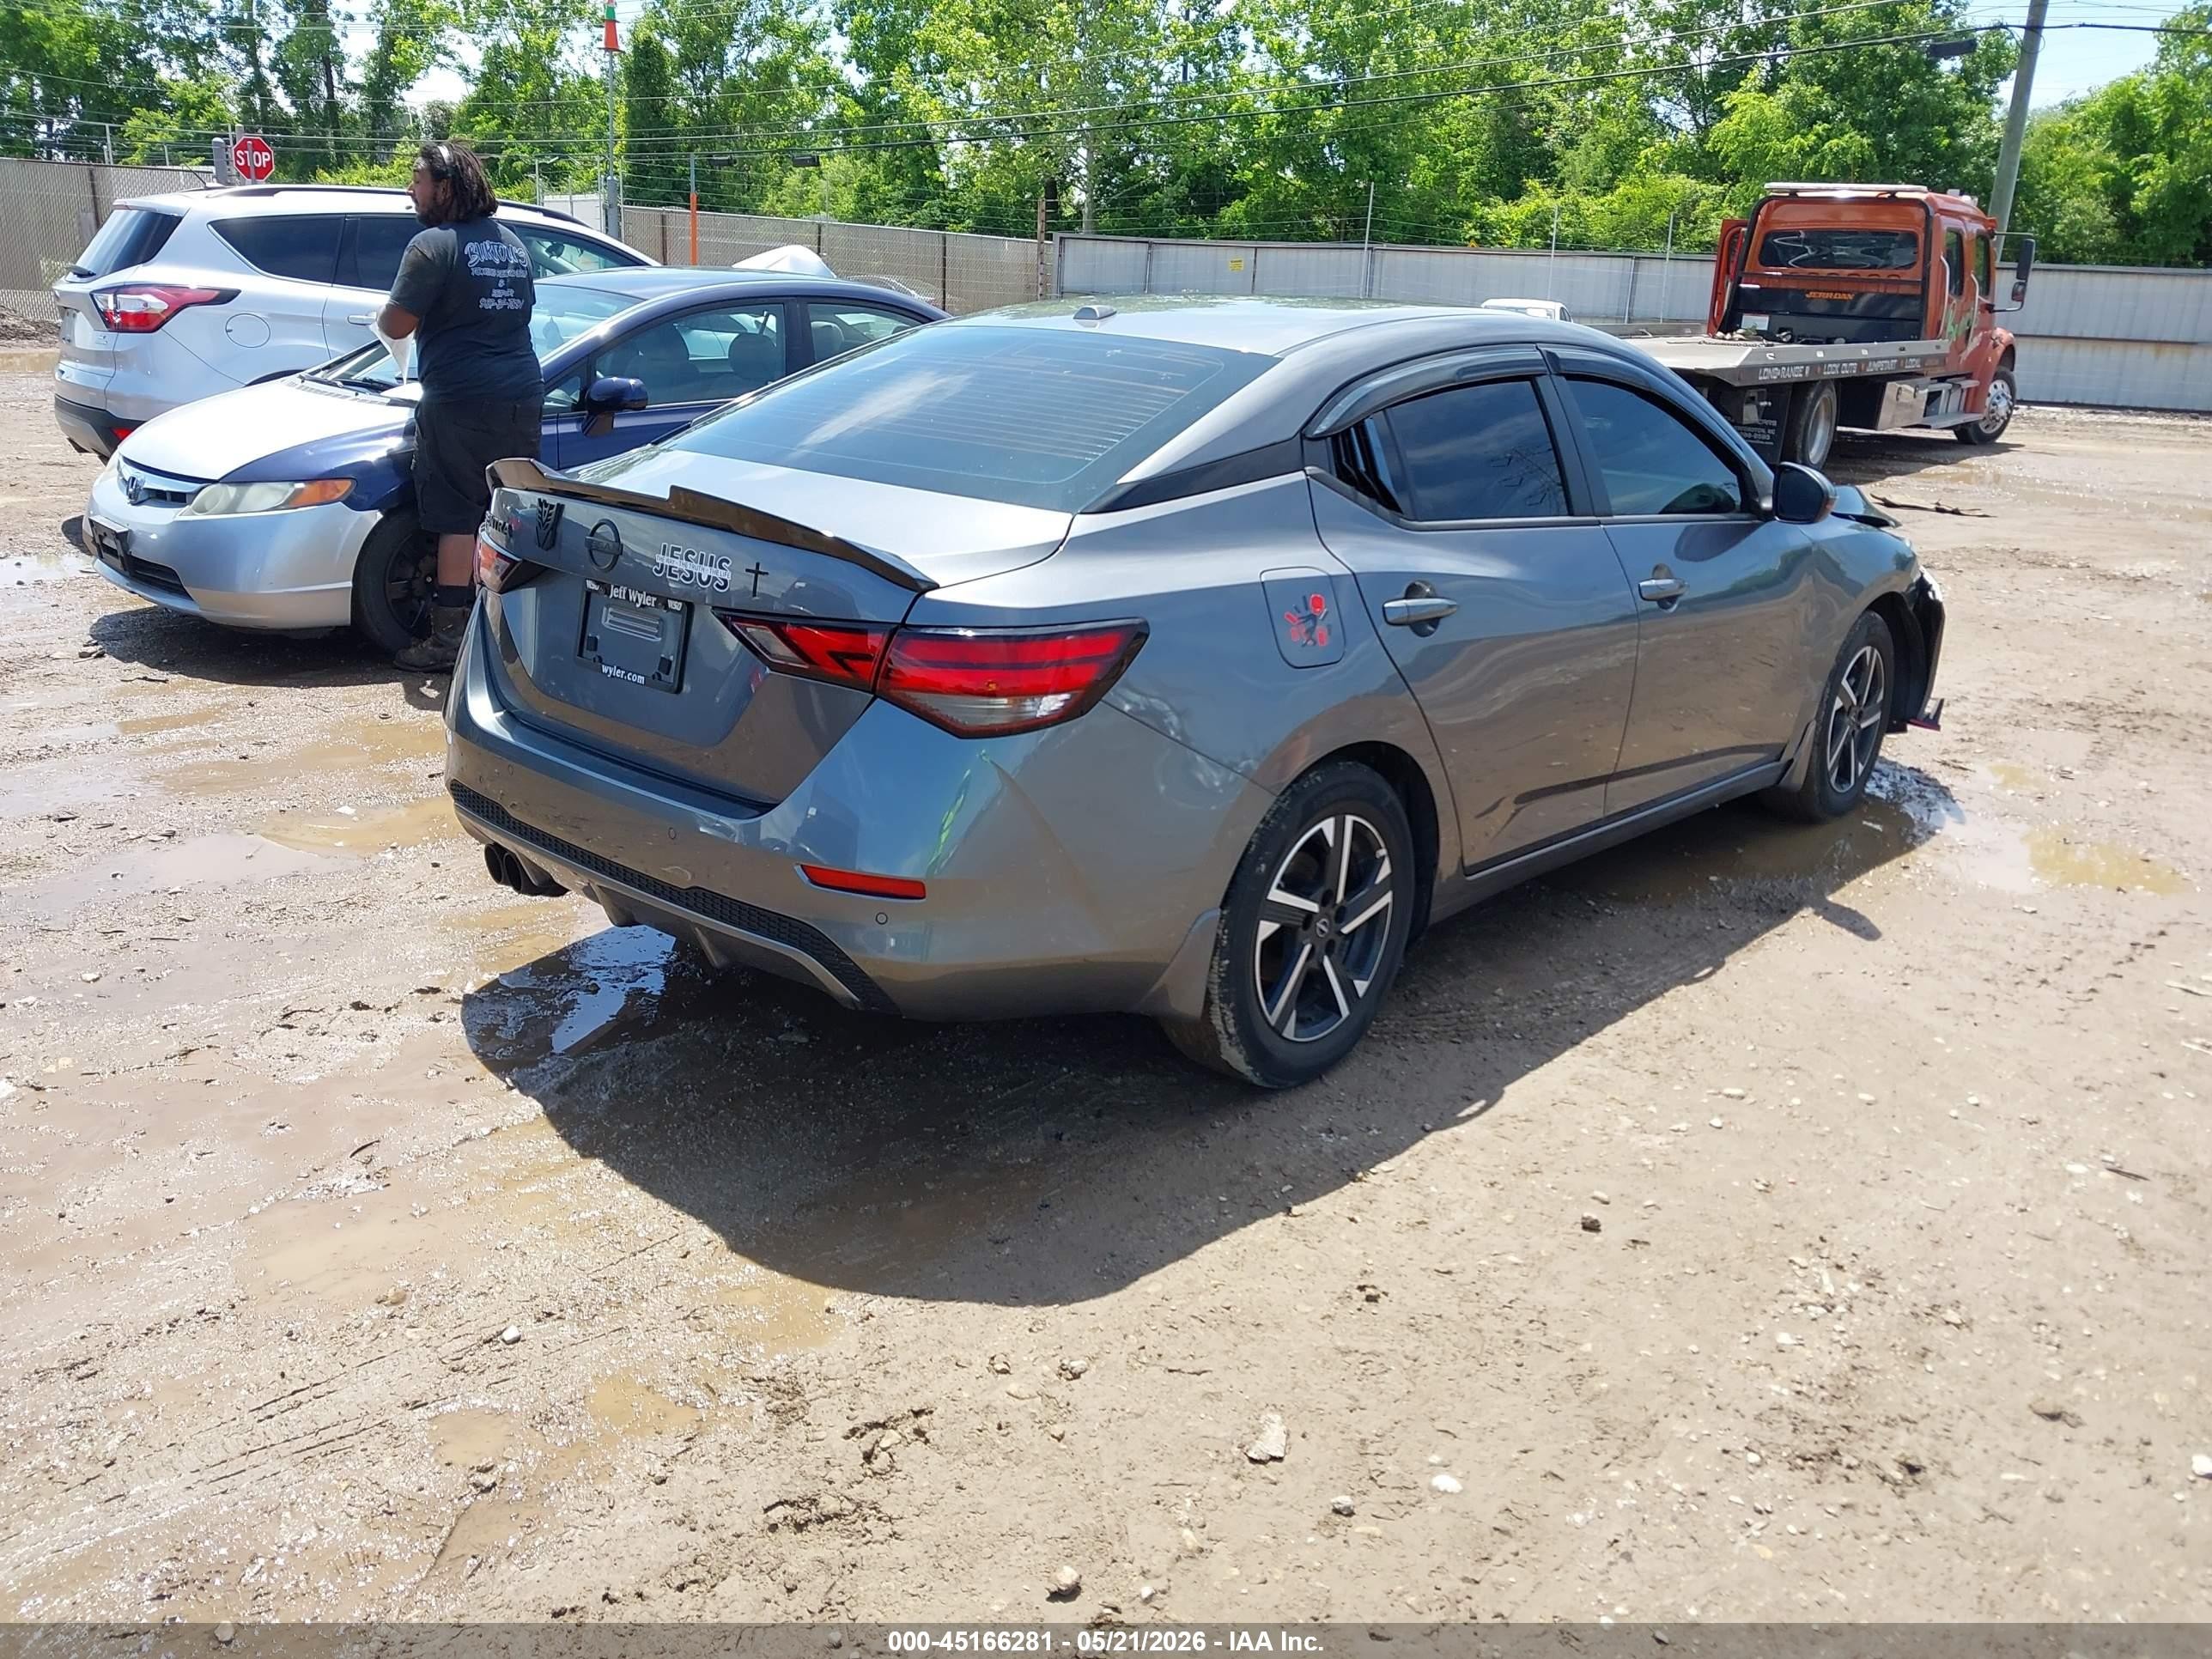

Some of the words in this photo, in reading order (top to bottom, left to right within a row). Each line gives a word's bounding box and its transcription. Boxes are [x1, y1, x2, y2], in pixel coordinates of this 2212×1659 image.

[236, 150, 270, 167] STOP
[653, 542, 732, 592] JESUS
[609, 584, 628, 599] Jeff
[629, 588, 657, 608] Wyler
[602, 665, 645, 685] wyler.com
